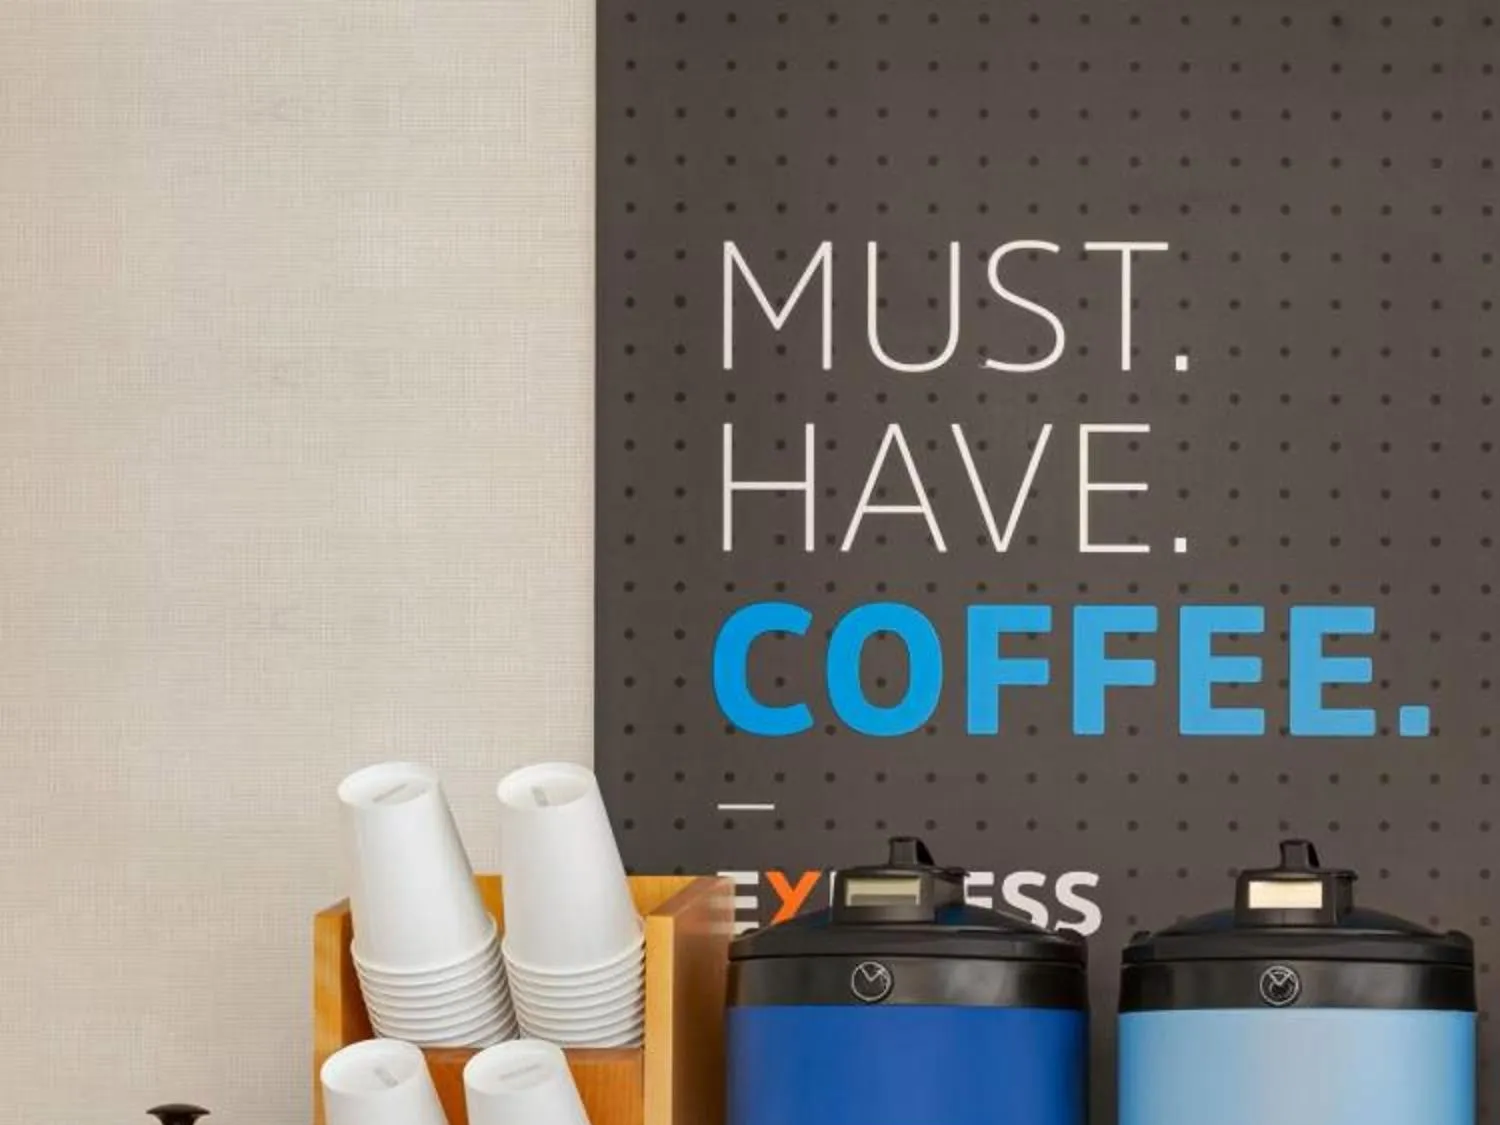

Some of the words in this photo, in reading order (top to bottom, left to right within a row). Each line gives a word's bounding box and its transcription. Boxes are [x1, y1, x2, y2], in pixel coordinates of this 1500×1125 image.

[723, 239, 1188, 372] MUST.
[722, 423, 1187, 552] HAVE.
[712, 602, 1430, 736] COFFEE.
